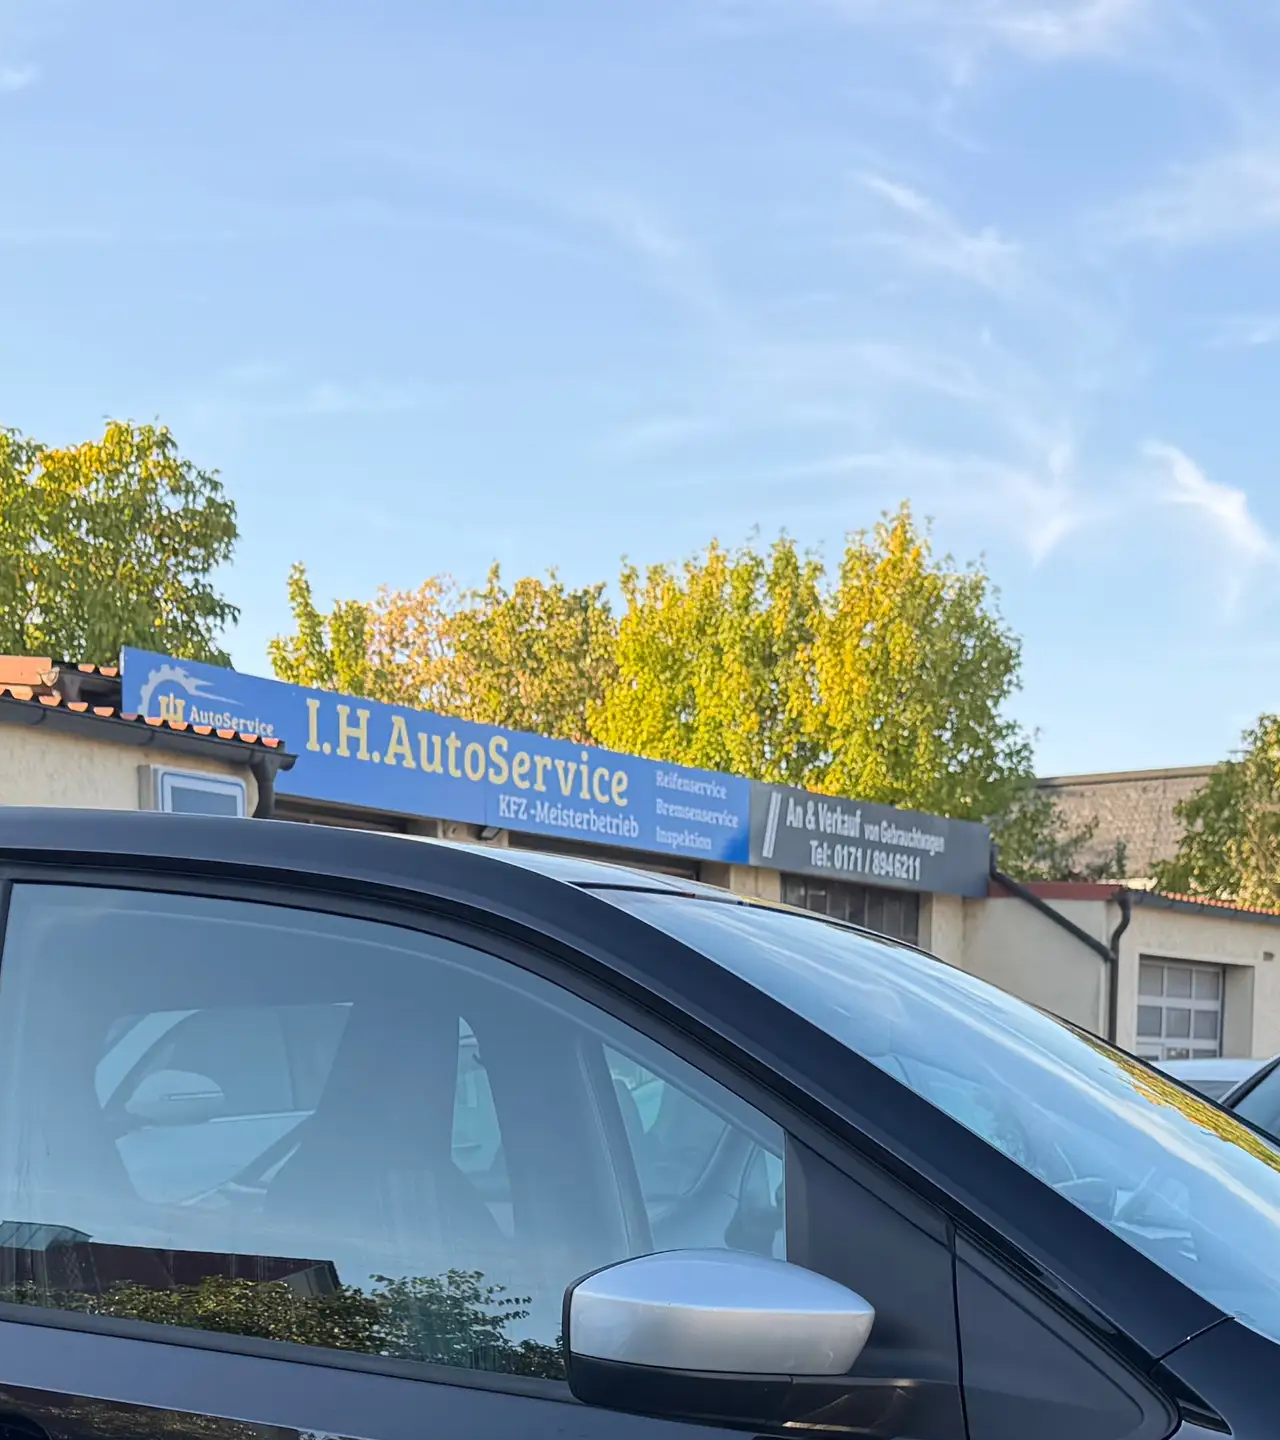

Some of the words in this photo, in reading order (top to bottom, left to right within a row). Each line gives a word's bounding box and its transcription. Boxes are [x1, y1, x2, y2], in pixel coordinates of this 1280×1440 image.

[189, 704, 275, 737] AutoService
[306, 698, 629, 807] I.H.AutoService
[655, 769, 728, 800] Reifenservice
[655, 798, 739, 829] Bremsenservice
[786, 797, 803, 828] An
[805, 800, 816, 831] &
[818, 802, 862, 838] Verkauf
[864, 822, 879, 843] von
[655, 825, 713, 851] Inspektion
[809, 839, 831, 868] Tel:
